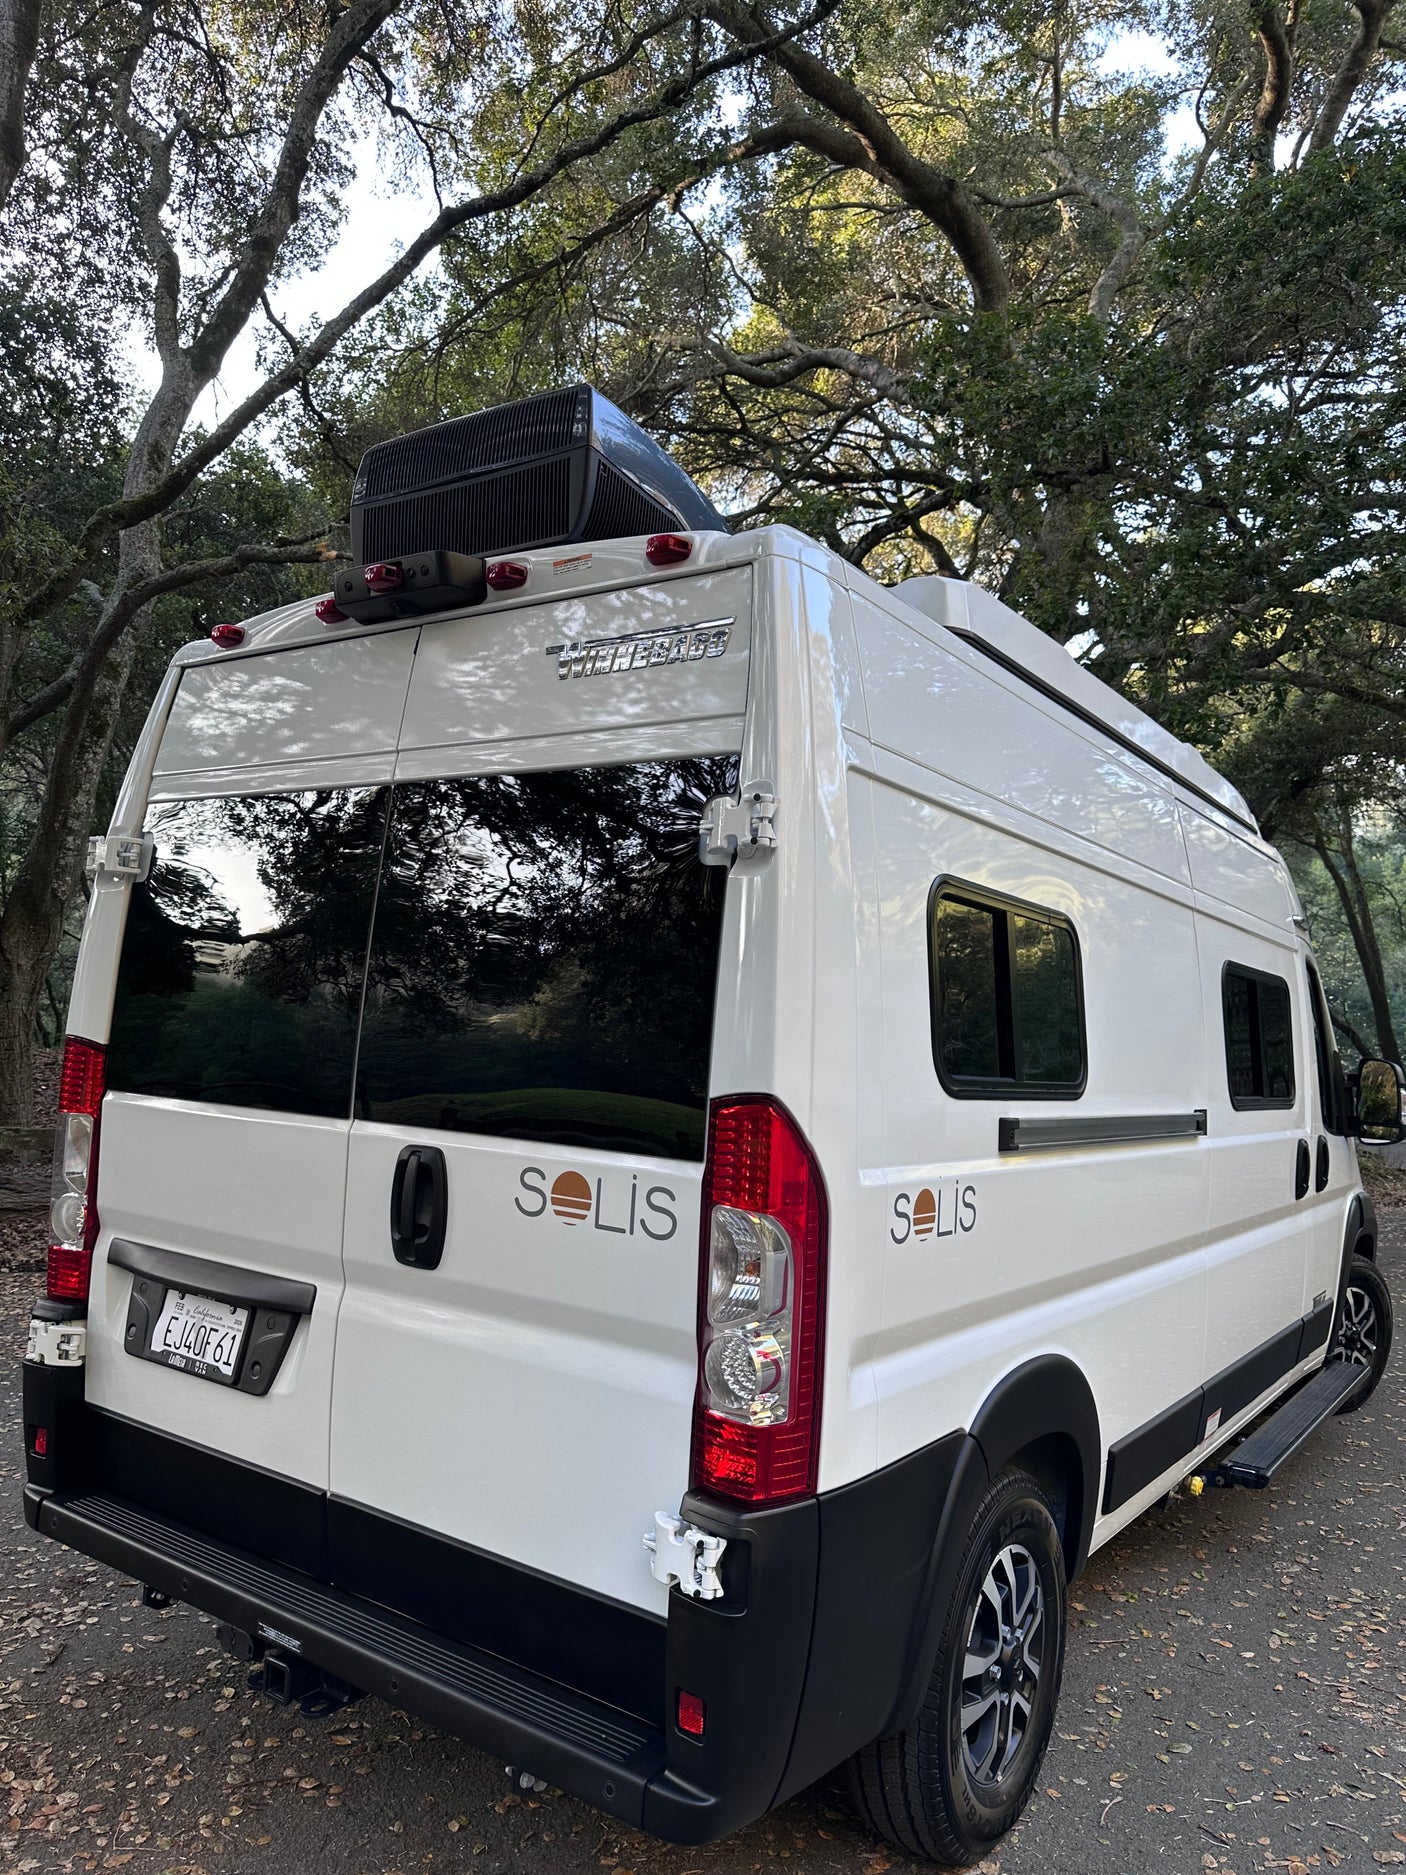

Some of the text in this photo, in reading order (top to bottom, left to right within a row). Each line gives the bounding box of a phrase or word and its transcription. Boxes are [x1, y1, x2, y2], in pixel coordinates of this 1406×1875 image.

[546, 617, 736, 680] WINNEBAGO
[175, 1301, 185, 1311] FEB
[193, 1305, 223, 1322] California
[163, 1315, 237, 1367] EJ40F61
[194, 1366, 207, 1375] VAN
